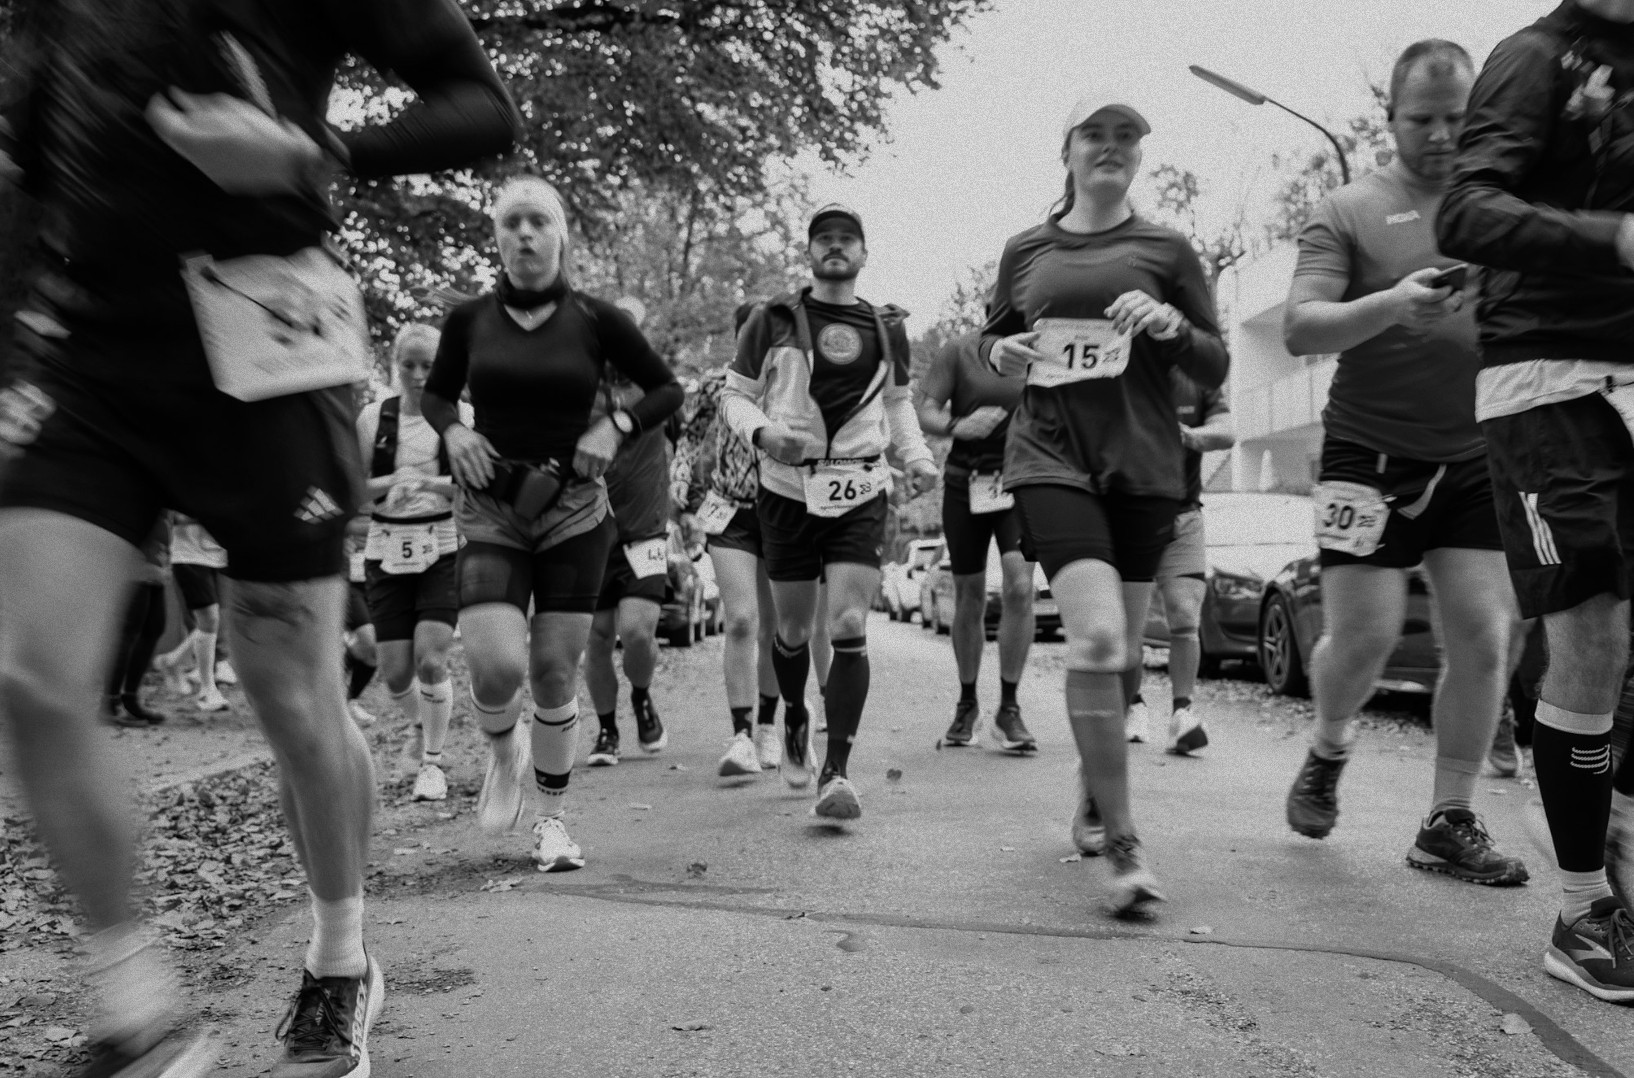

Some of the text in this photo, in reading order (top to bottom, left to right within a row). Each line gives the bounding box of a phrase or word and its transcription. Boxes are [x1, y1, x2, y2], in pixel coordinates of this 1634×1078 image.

[1063, 344, 1100, 370] 15
[829, 480, 858, 502] 26
[1323, 502, 1356, 530] 30
[402, 541, 413, 559] 5
